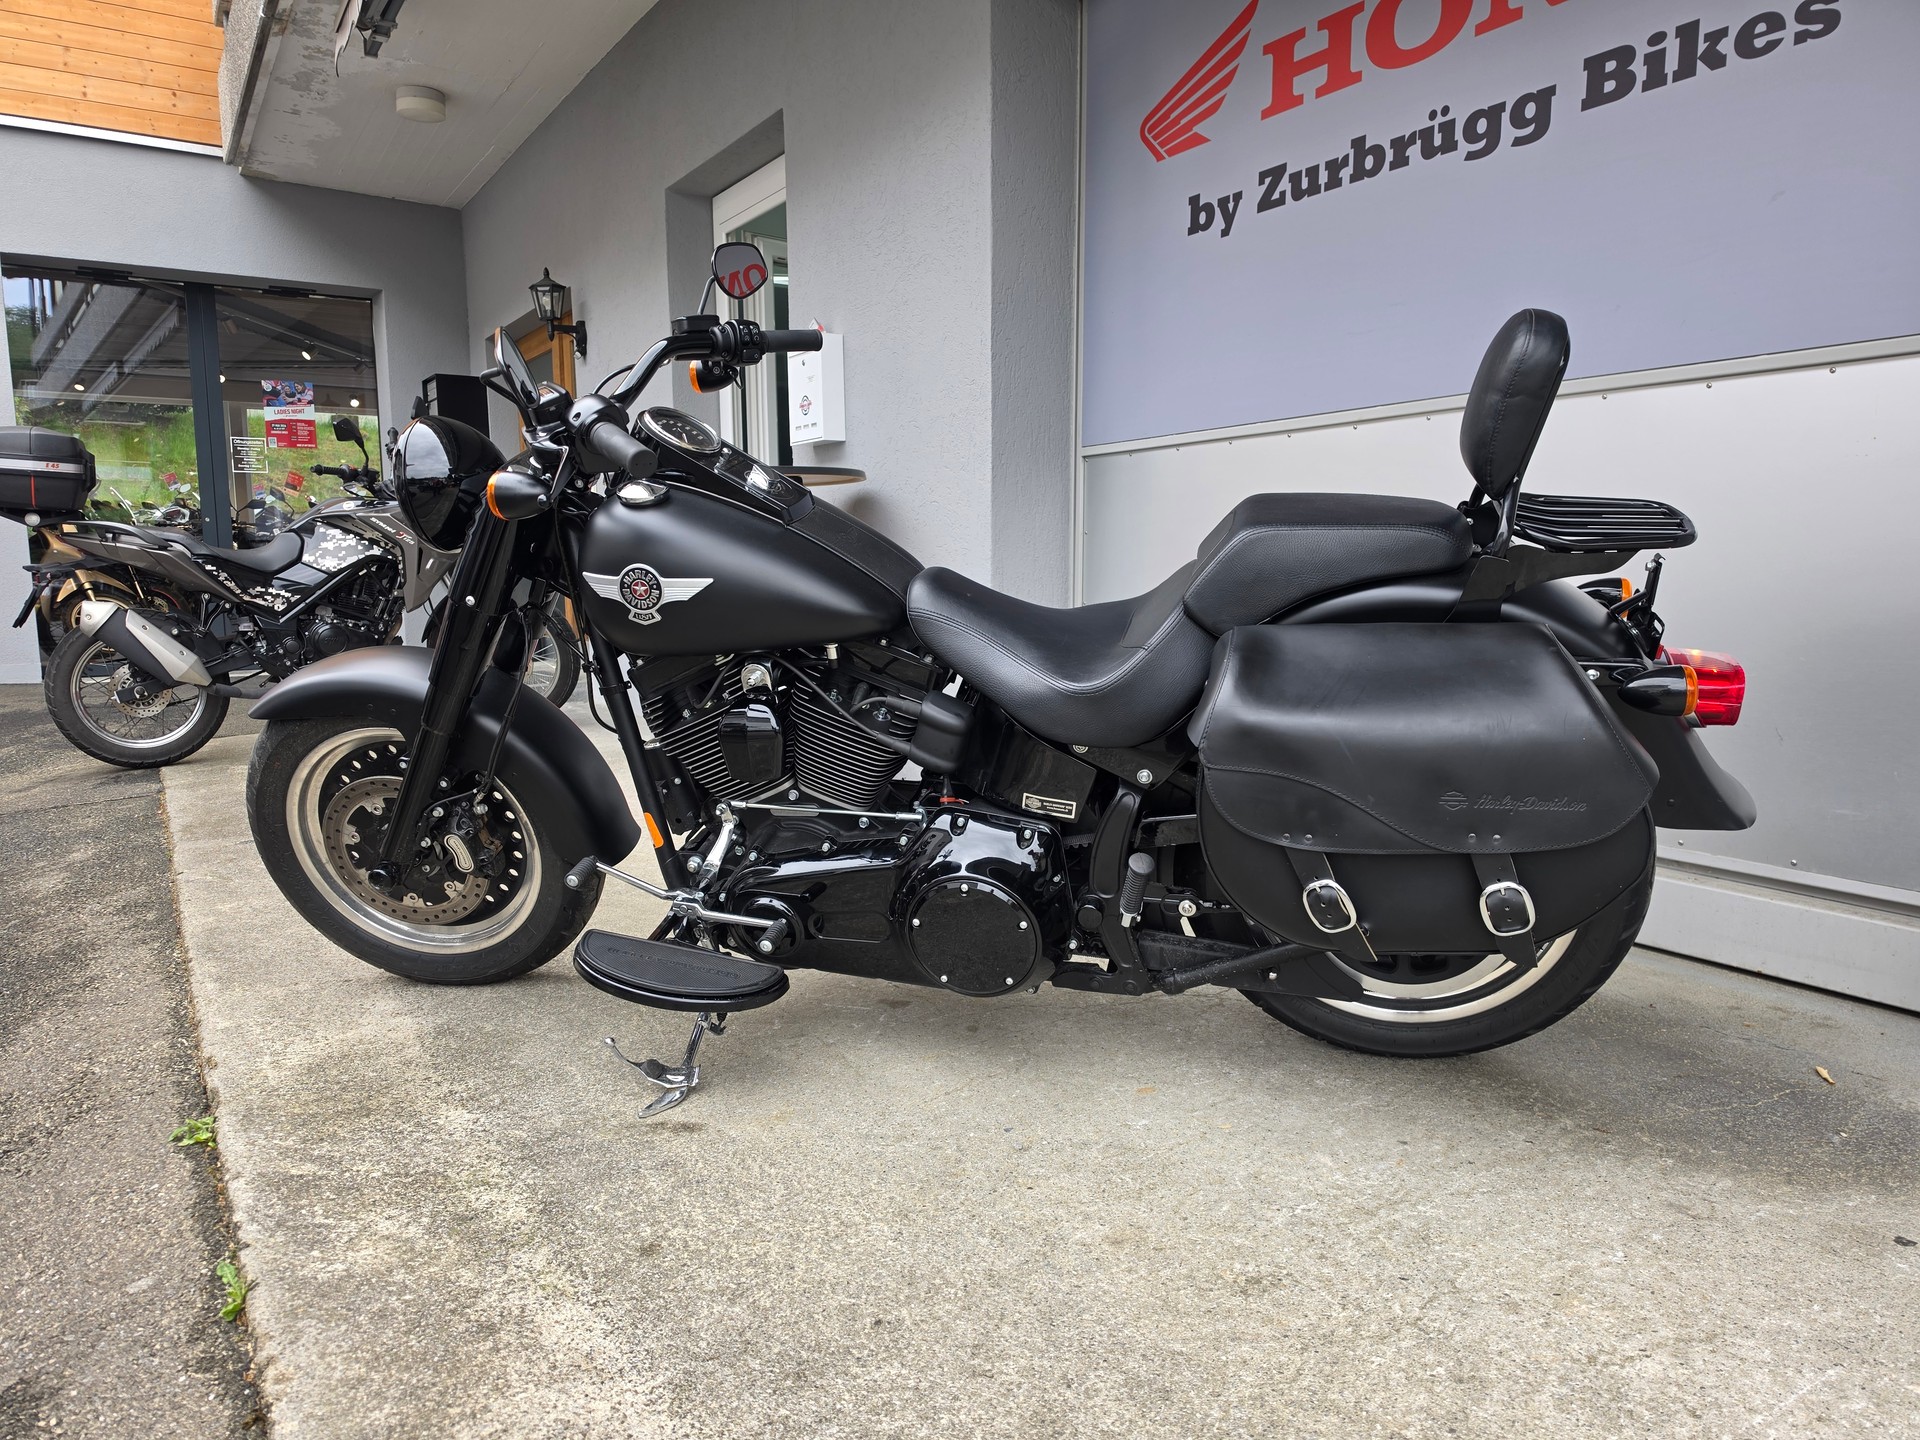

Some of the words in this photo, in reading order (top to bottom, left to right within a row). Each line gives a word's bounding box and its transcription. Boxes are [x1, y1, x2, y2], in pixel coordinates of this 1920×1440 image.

[1187, 193, 1243, 238] by
[1256, 83, 1557, 214] Zurbrügg
[1580, 0, 1842, 112] Bikes
[623, 570, 657, 585] HARLEY
[622, 589, 659, 609] DAVIDSON
